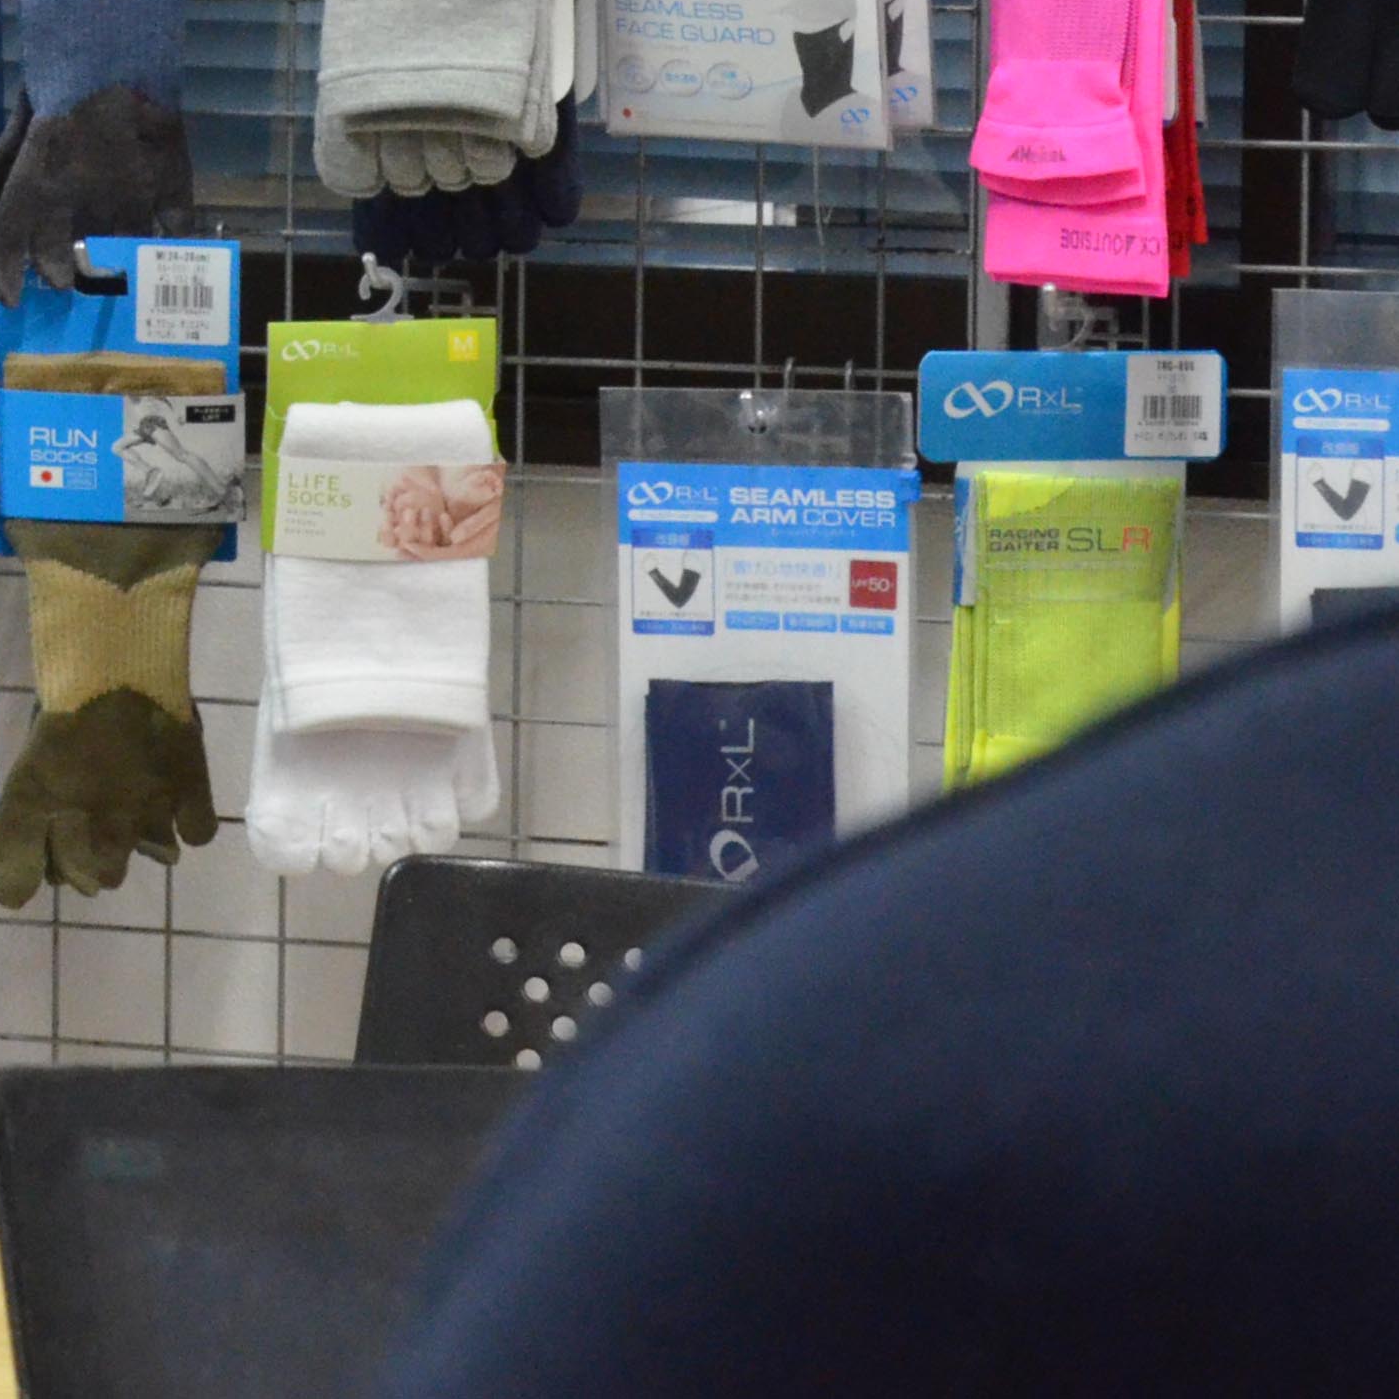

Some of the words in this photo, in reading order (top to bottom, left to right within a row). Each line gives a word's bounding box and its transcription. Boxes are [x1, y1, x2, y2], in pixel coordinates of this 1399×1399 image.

[615, 17, 676, 41] FACE
[680, 22, 777, 46] GUARD
[29, 426, 98, 449] RUN
[29, 449, 98, 465] SOCKS
[287, 472, 340, 492] LIFE
[287, 489, 353, 510] SOCKS
[729, 486, 897, 509] SEAMLESS
[729, 507, 798, 526] ARM
[802, 508, 897, 528] COVER
[989, 528, 1060, 541] RACING
[989, 539, 1060, 553] GAITER
